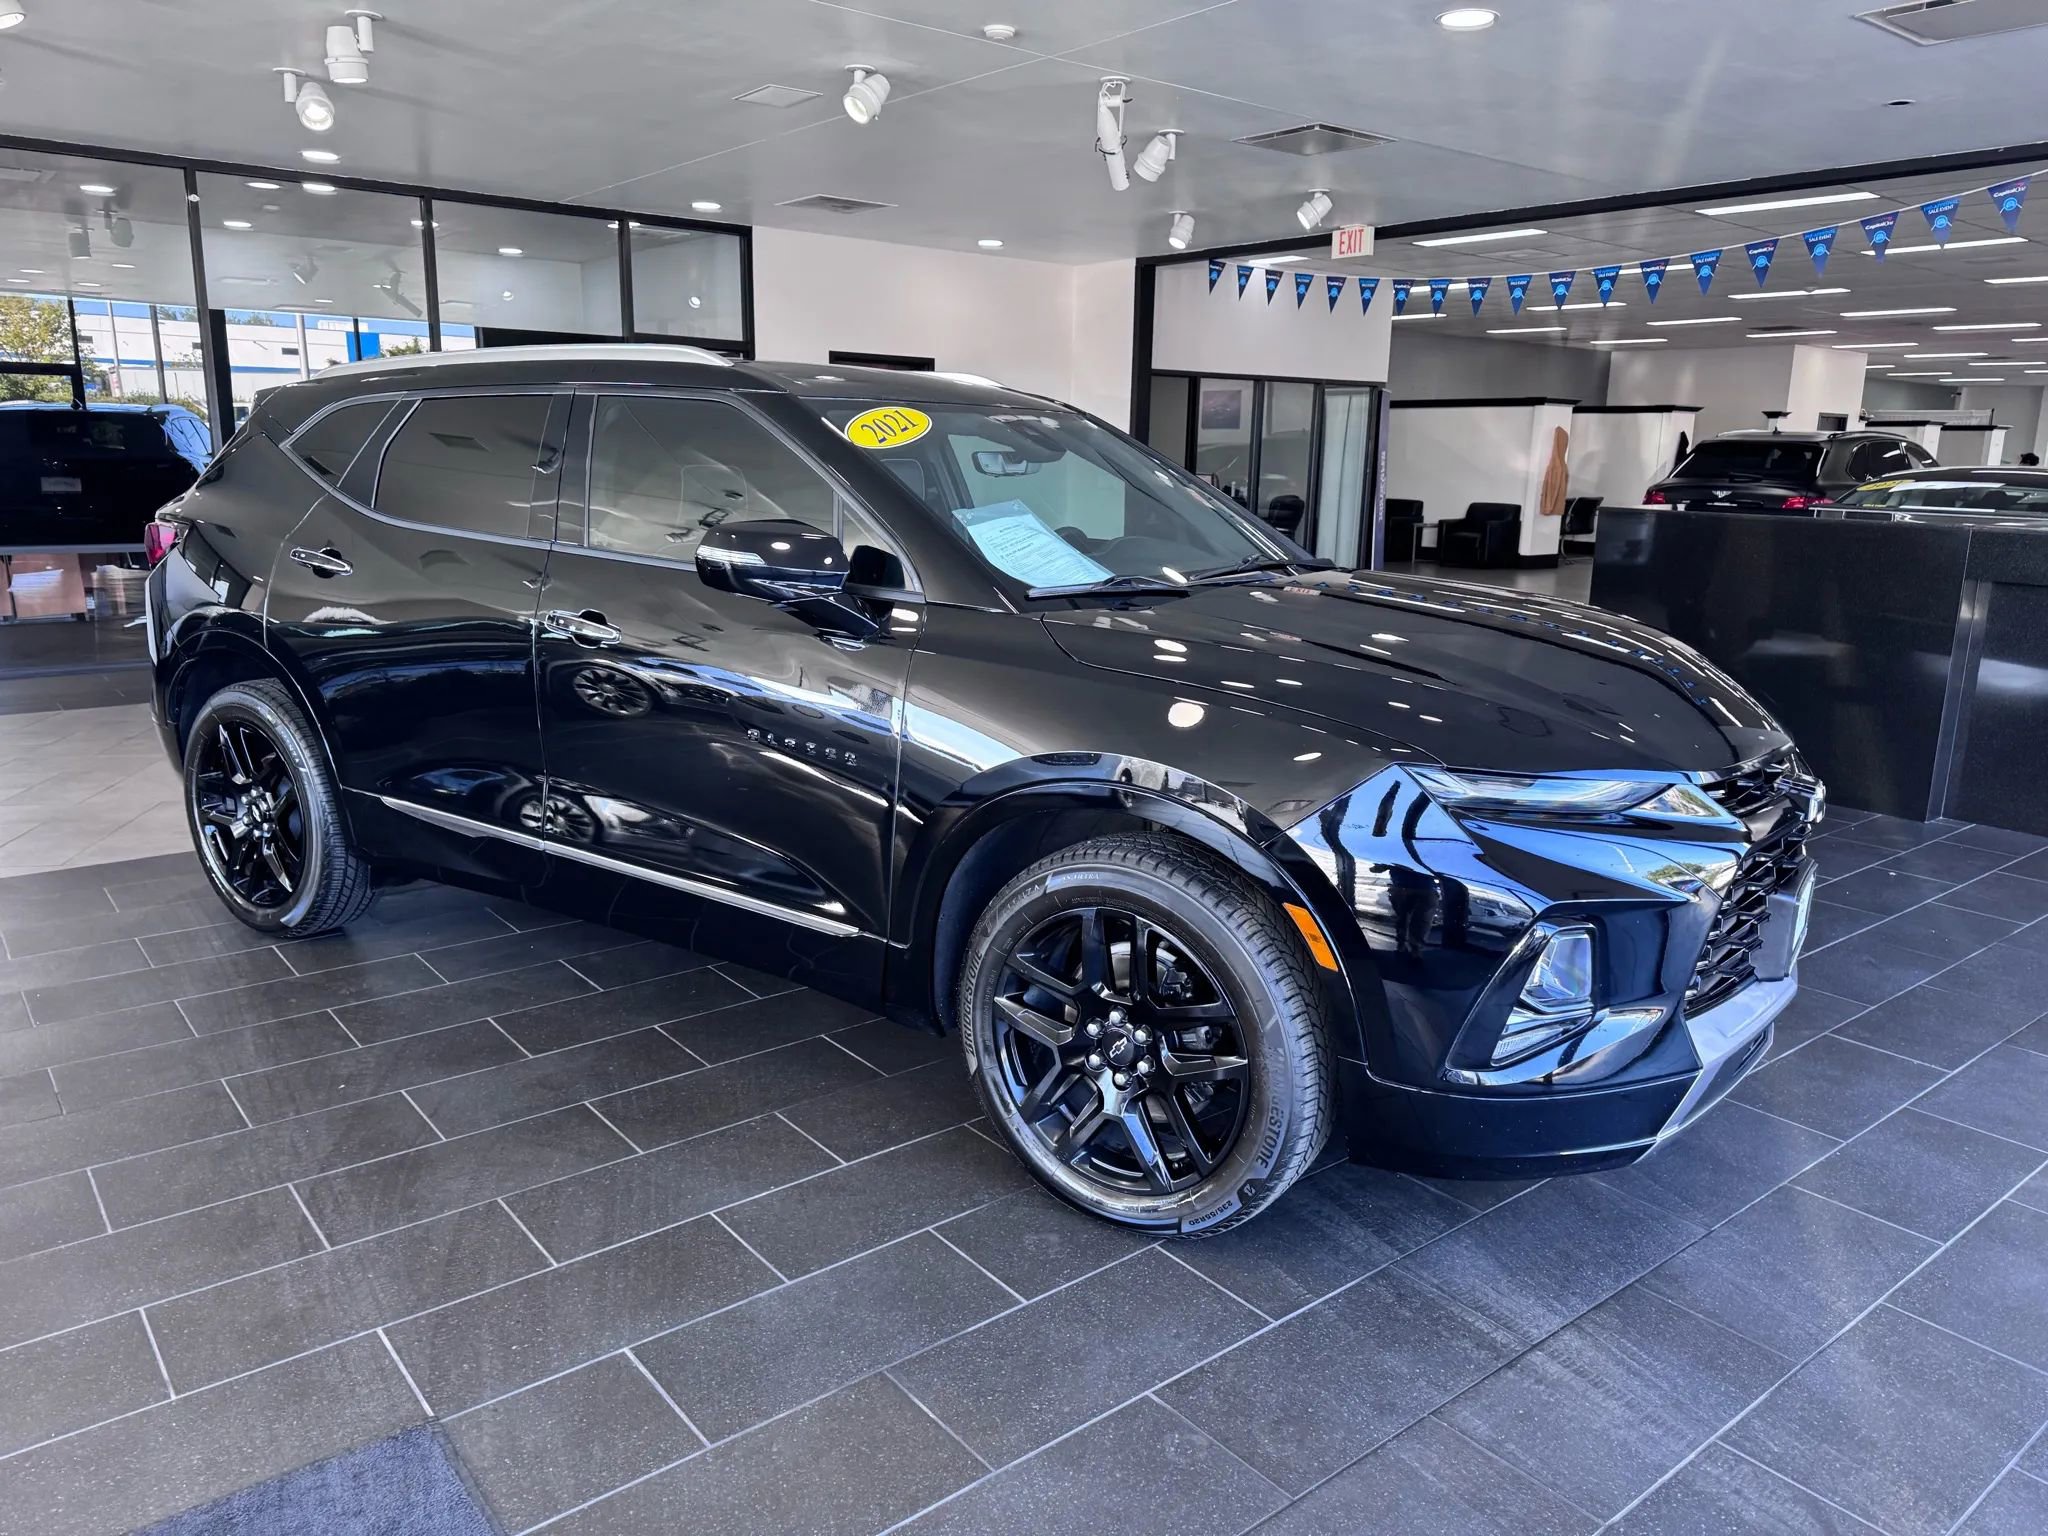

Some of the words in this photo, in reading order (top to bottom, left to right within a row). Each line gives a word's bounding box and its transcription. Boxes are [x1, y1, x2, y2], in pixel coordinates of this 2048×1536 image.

[1338, 228, 1365, 256] EXIT
[860, 410, 919, 444] 2021
[962, 949, 983, 1059] BRIDGESTONE
[1189, 1200, 1233, 1226] 235/55R20
